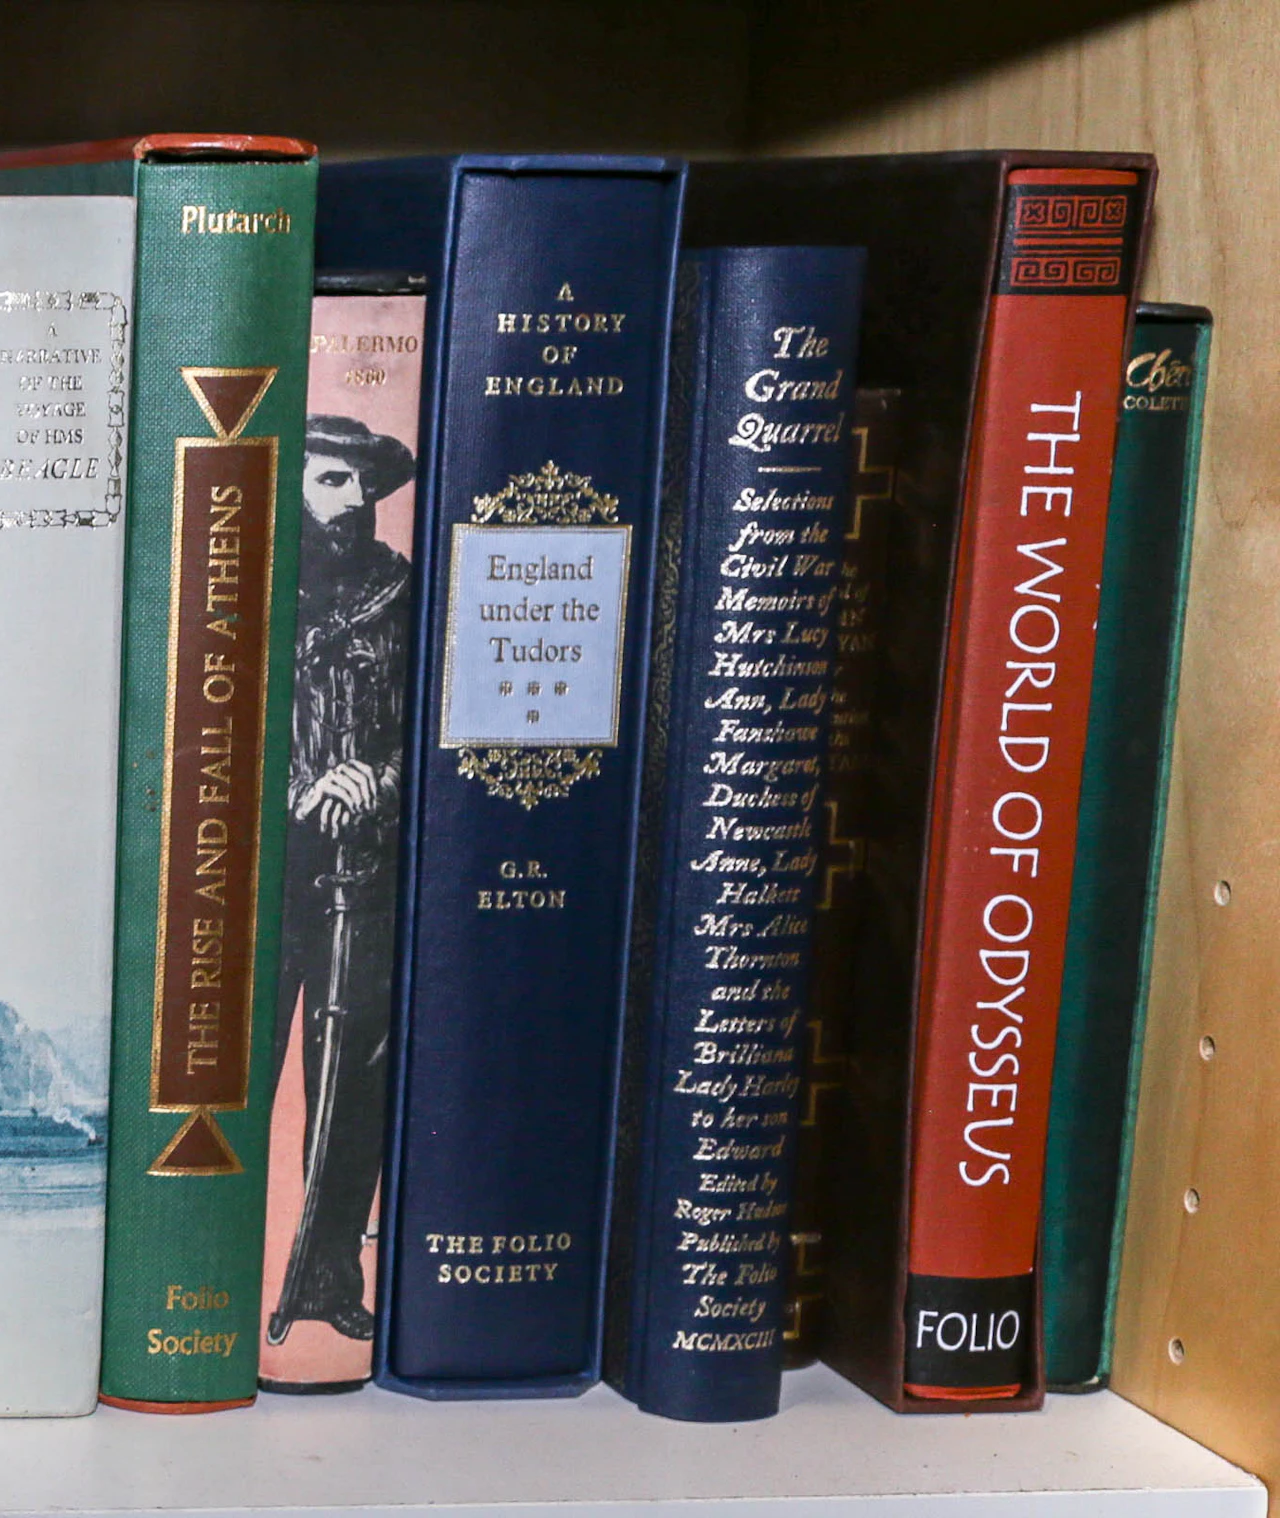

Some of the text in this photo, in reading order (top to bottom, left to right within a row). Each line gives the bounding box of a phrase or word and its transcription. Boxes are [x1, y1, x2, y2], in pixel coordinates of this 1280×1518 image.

[180, 205, 291, 234] Plutarch
[556, 282, 574, 302] A
[497, 312, 627, 334] HISTORY
[310, 335, 418, 353] PALERMO
[543, 344, 578, 365] OF
[773, 325, 829, 360] The
[0, 349, 102, 365] NARRATIVE
[19, 375, 83, 392] OF THE
[485, 375, 625, 397] ENGLAND
[744, 369, 841, 403] Grand
[16, 402, 86, 418] VOYAGE
[16, 429, 84, 444] OF HMS
[729, 412, 842, 452] Quarrel
[0, 458, 101, 480] BEAGLE
[733, 488, 834, 513] Selections
[729, 522, 829, 552] from the
[487, 554, 594, 585] England
[720, 554, 835, 580] Civil War
[480, 597, 600, 623] under the
[715, 587, 814, 611] Memoirs
[715, 620, 829, 652] Mrs Lucy
[490, 637, 582, 664] Tudors
[705, 687, 830, 715] Ann, Lady
[187, 484, 243, 1075] THE RISE AND FALL OF ATHENS
[958, 390, 1083, 1187] THE WORLD OF ODYSSEUS
[704, 784, 798, 808] Duchess
[500, 860, 547, 880] G.R.
[773, 848, 818, 877] Lady
[478, 889, 566, 909] ELTON
[693, 914, 808, 937] Mrs Alice
[711, 980, 757, 1000] and
[694, 1008, 775, 1033] Letters
[673, 1069, 737, 1102] Lady
[691, 1109, 715, 1127] to
[720, 1106, 759, 1128] her
[692, 1135, 785, 1160] Edward
[673, 1198, 732, 1226] Roger
[426, 1231, 572, 1254] THE FOLIO
[438, 1262, 558, 1284] SOCIETY
[682, 1261, 728, 1285] The
[166, 1284, 229, 1310] Folio
[694, 1295, 767, 1323] Society
[147, 1328, 237, 1357] Society
[916, 1310, 1021, 1353] FOLIO
